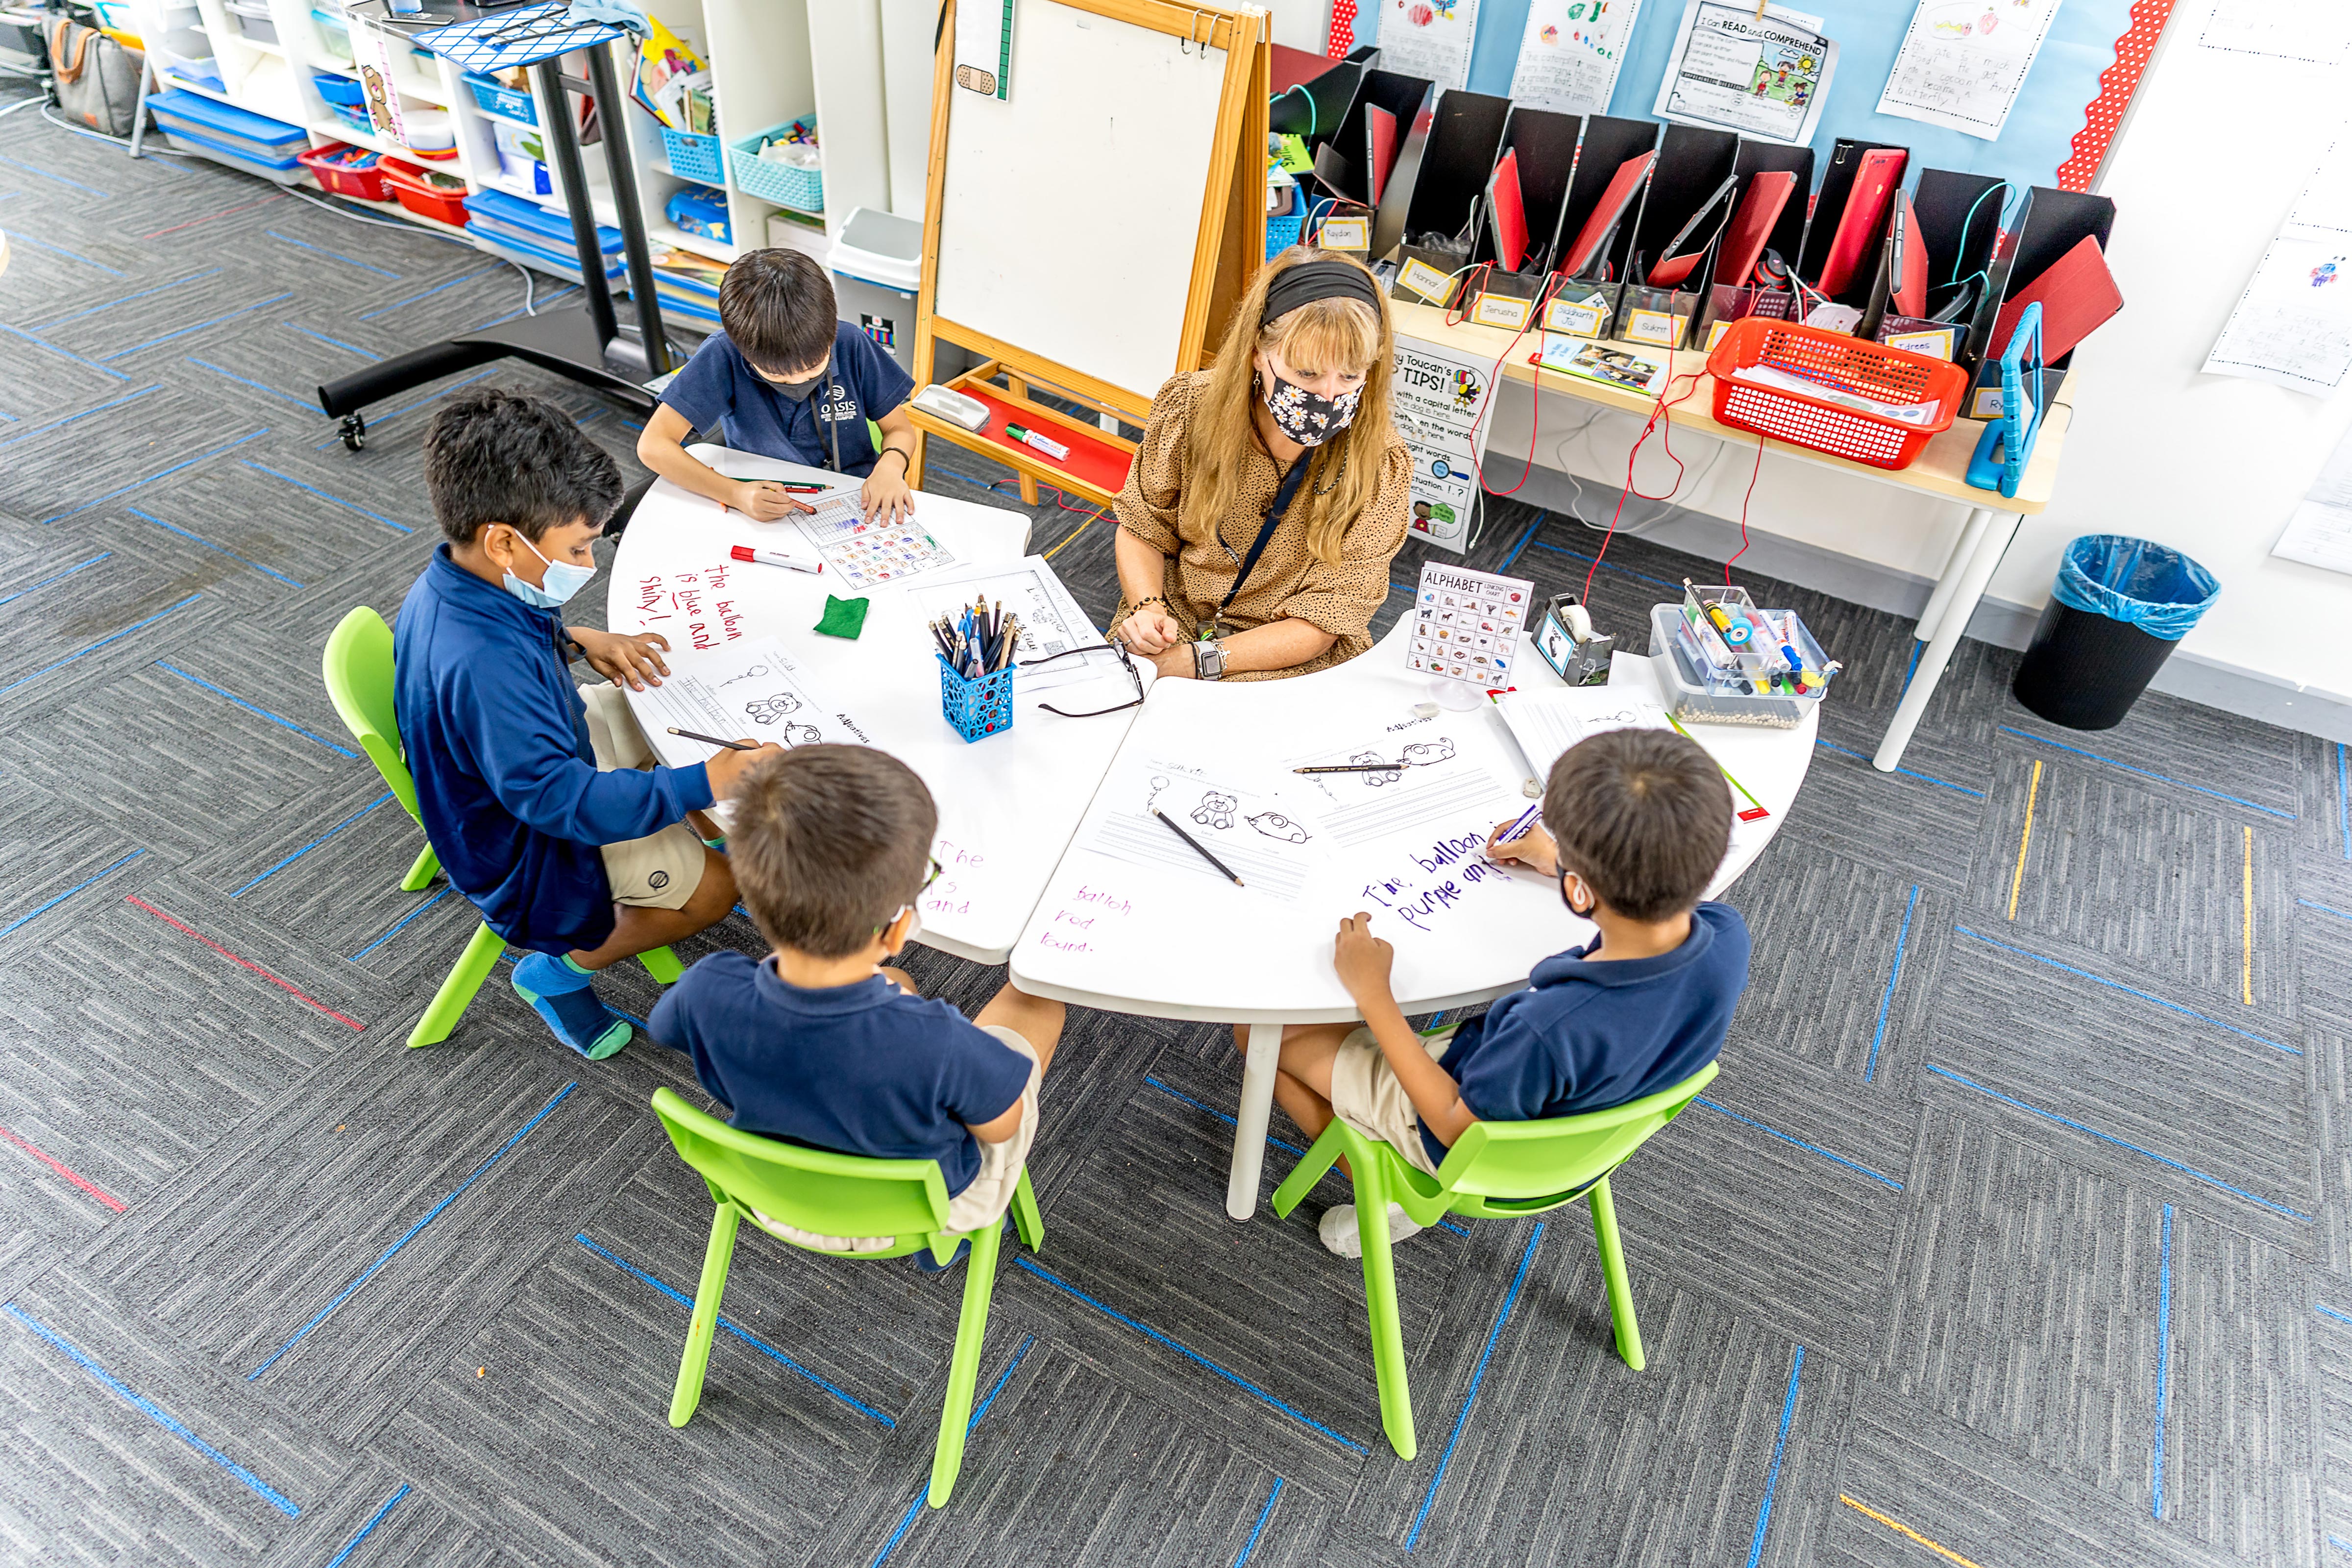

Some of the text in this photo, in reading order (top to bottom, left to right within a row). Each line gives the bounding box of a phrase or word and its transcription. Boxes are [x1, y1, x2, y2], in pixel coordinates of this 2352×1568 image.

[1707, 19, 1720, 28] Can
[1722, 21, 1747, 34] READ
[1747, 29, 1763, 38] and
[1764, 30, 1822, 55] COMPREHEND
[1484, 305, 1518, 318] Jerusha
[1557, 305, 1594, 321] Siddharth
[1562, 317, 1576, 326] Jai
[1407, 354, 1452, 376] Toucan's
[1404, 367, 1445, 393] TIPS!
[1423, 398, 1450, 411] capital
[1452, 405, 1478, 419] letter.
[1395, 412, 1429, 428] beten
[1432, 423, 1445, 432] the
[1400, 423, 1414, 433] dog
[1426, 449, 1452, 463] words.
[1425, 572, 1504, 594] ALPHABET LINKING
[675, 574, 720, 649] is blue and
[1551, 626, 1561, 641] Tape
[939, 840, 983, 868] The
[1409, 833, 1486, 874] balloon
[927, 901, 970, 914] and
[1397, 881, 1462, 931] purple
[1041, 932, 1093, 952] round.
